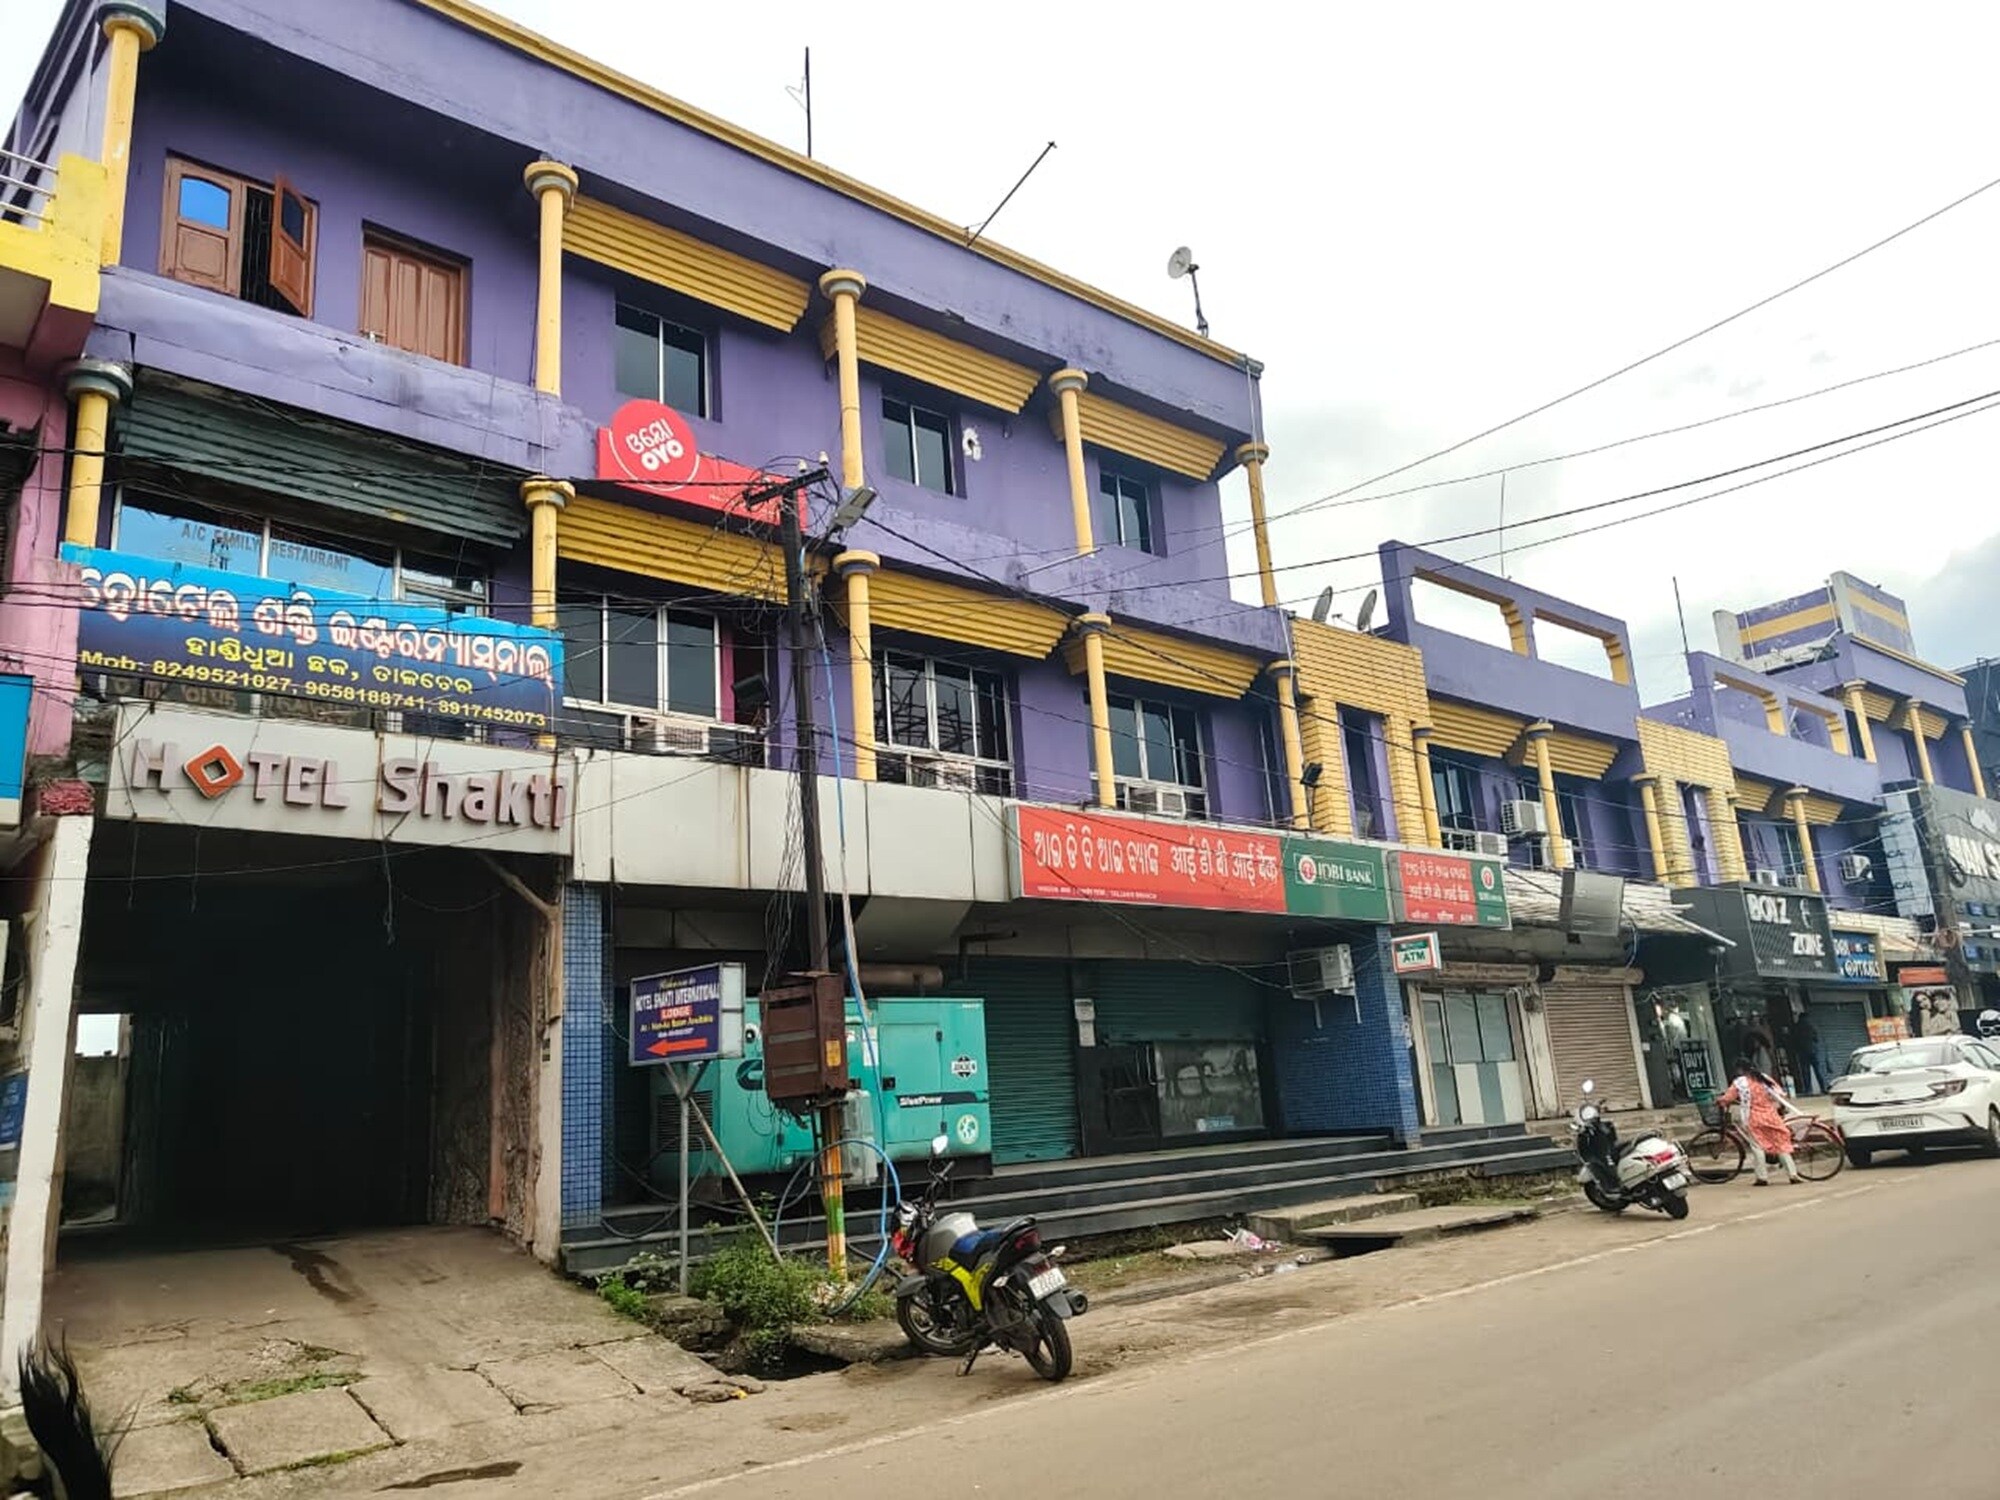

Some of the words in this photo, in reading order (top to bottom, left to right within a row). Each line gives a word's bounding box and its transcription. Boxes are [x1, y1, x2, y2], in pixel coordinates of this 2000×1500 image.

[641, 439, 684, 471] OYO
[181, 523, 206, 541] A/C
[214, 529, 263, 555] FAMILY
[272, 541, 350, 572] RESTAURANT
[132, 737, 349, 810] HOTEL
[379, 757, 568, 830] Shakti
[1170, 834, 1197, 882] आई
[1231, 842, 1256, 887] आई
[1318, 862, 1345, 880] IDBI
[1345, 868, 1373, 884] BANK
[1789, 932, 1826, 956] ZONE
[1402, 951, 1426, 963] ATM
[1684, 1052, 1703, 1068] BUY
[1688, 1072, 1707, 1088] GET
